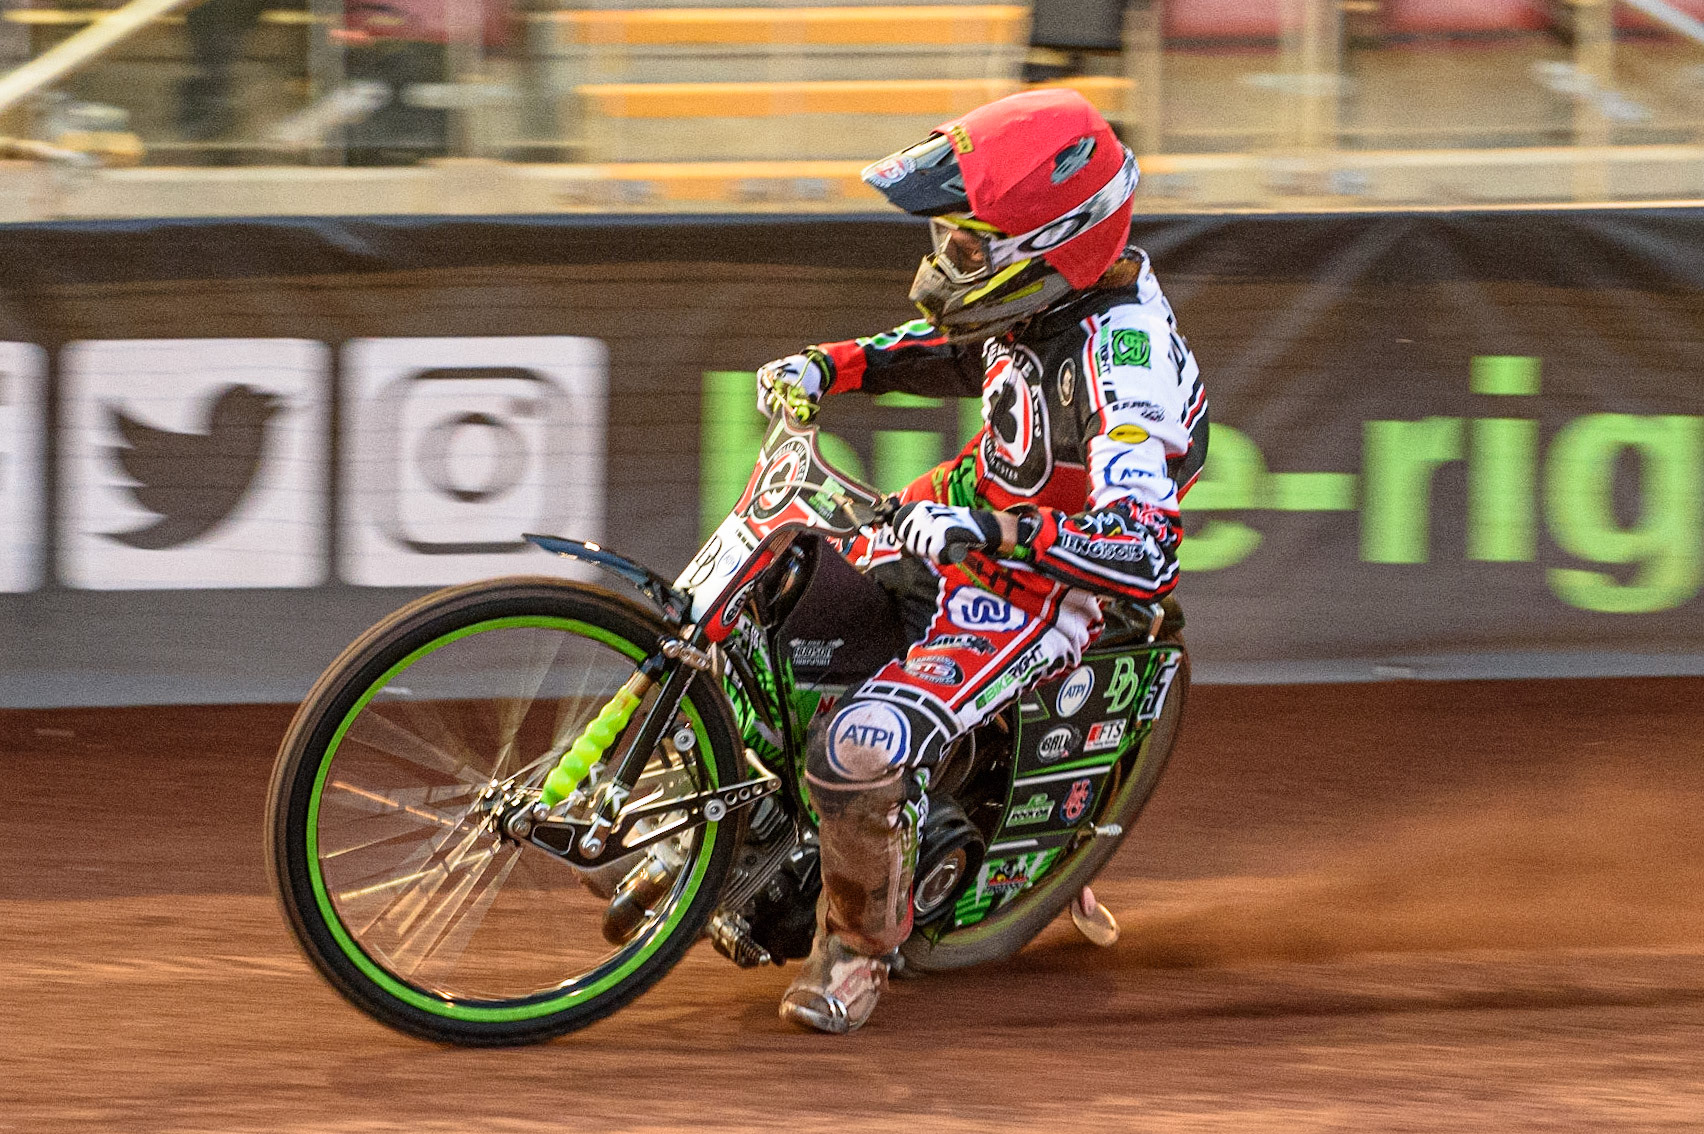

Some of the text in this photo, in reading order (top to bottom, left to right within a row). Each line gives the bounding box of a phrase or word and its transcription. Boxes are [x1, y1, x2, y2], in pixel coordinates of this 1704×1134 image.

[1063, 683, 1086, 699] ATPI
[838, 724, 895, 751] ATPI
[1099, 721, 1125, 741] FTS
